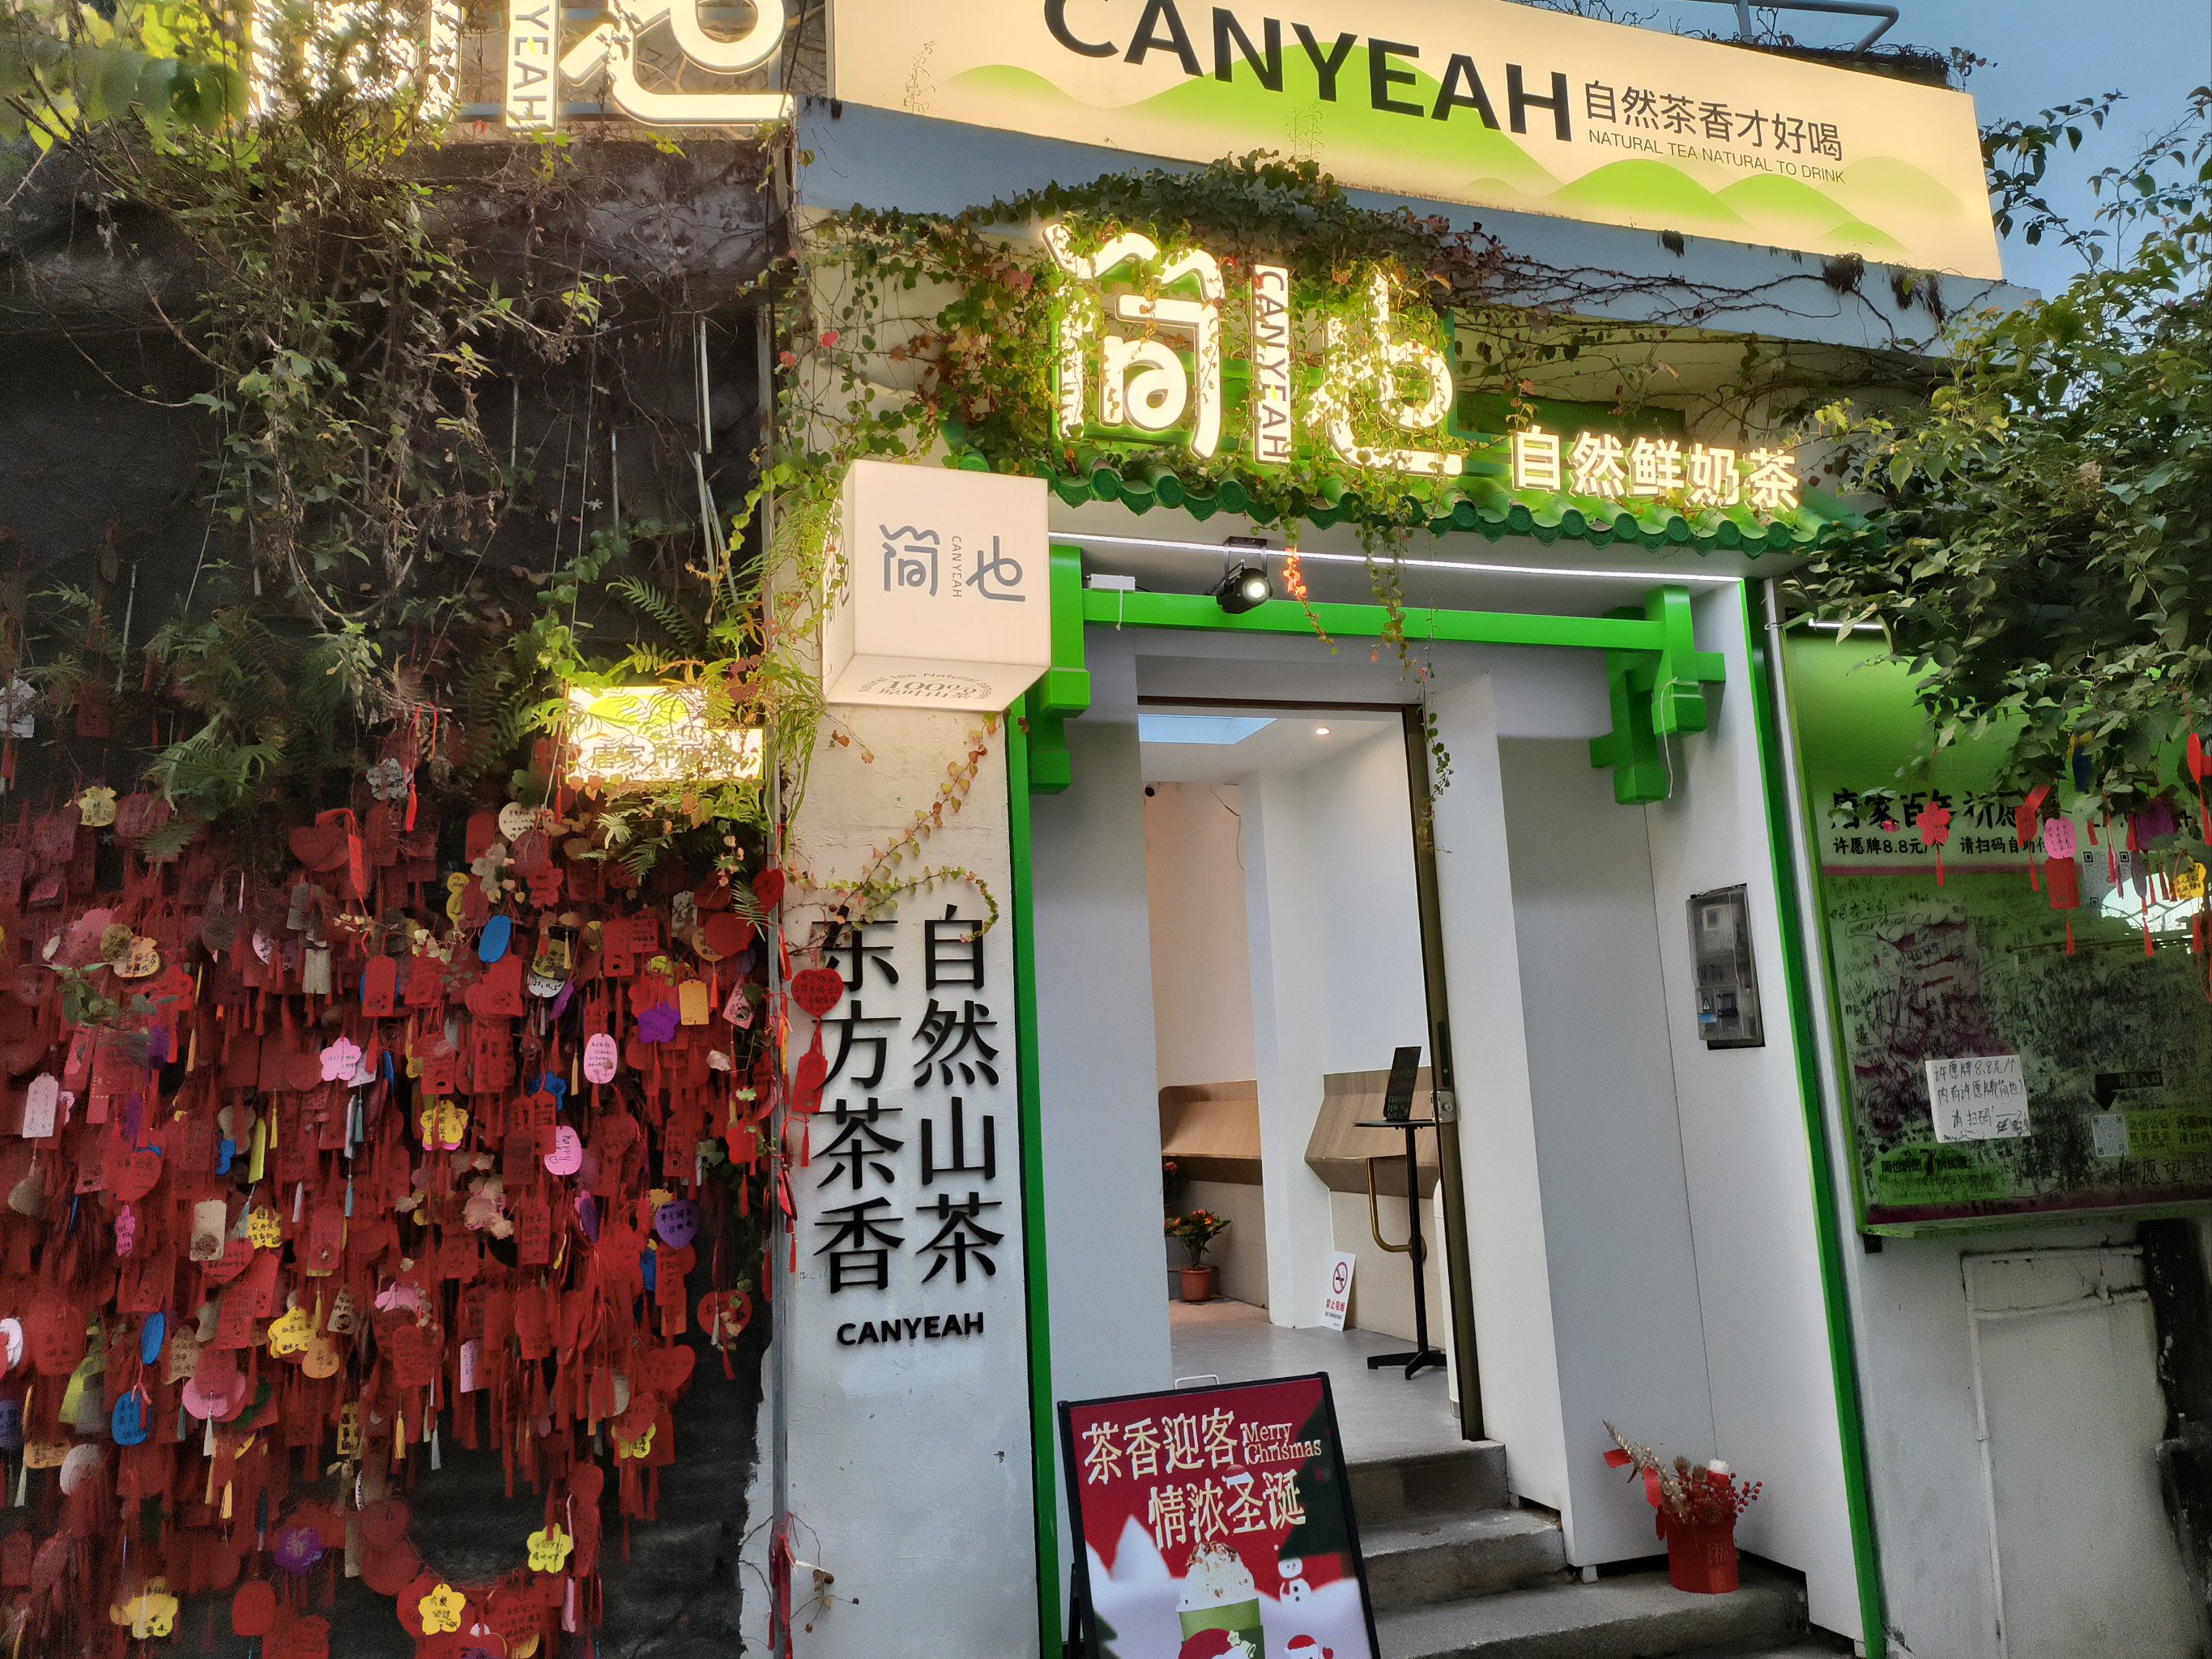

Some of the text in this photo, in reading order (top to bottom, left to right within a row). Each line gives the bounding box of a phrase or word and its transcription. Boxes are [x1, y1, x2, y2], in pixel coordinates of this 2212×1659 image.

[1044, 0, 1572, 142] CANYEAH
[1585, 79, 1843, 161] 自然茶香才好喝
[1589, 130, 1846, 184] NATURAL TEA NATURAL TO DRINK
[1259, 269, 1289, 463] CANYEAH
[1512, 425, 1799, 512] 自然鲜奶茶
[952, 535, 962, 599] CANYEAH
[887, 680, 977, 693] 100%
[812, 905, 905, 1294] 东方茶香
[913, 903, 1004, 1284] 自然山茶
[837, 1311, 984, 1346] CANYEAH
[1082, 1407, 1238, 1485] 茶香迎客
[1239, 1422, 1293, 1447] Merry
[1244, 1439, 1322, 1465] Chrismas
[1148, 1469, 1306, 1550] 情浓圣诞
